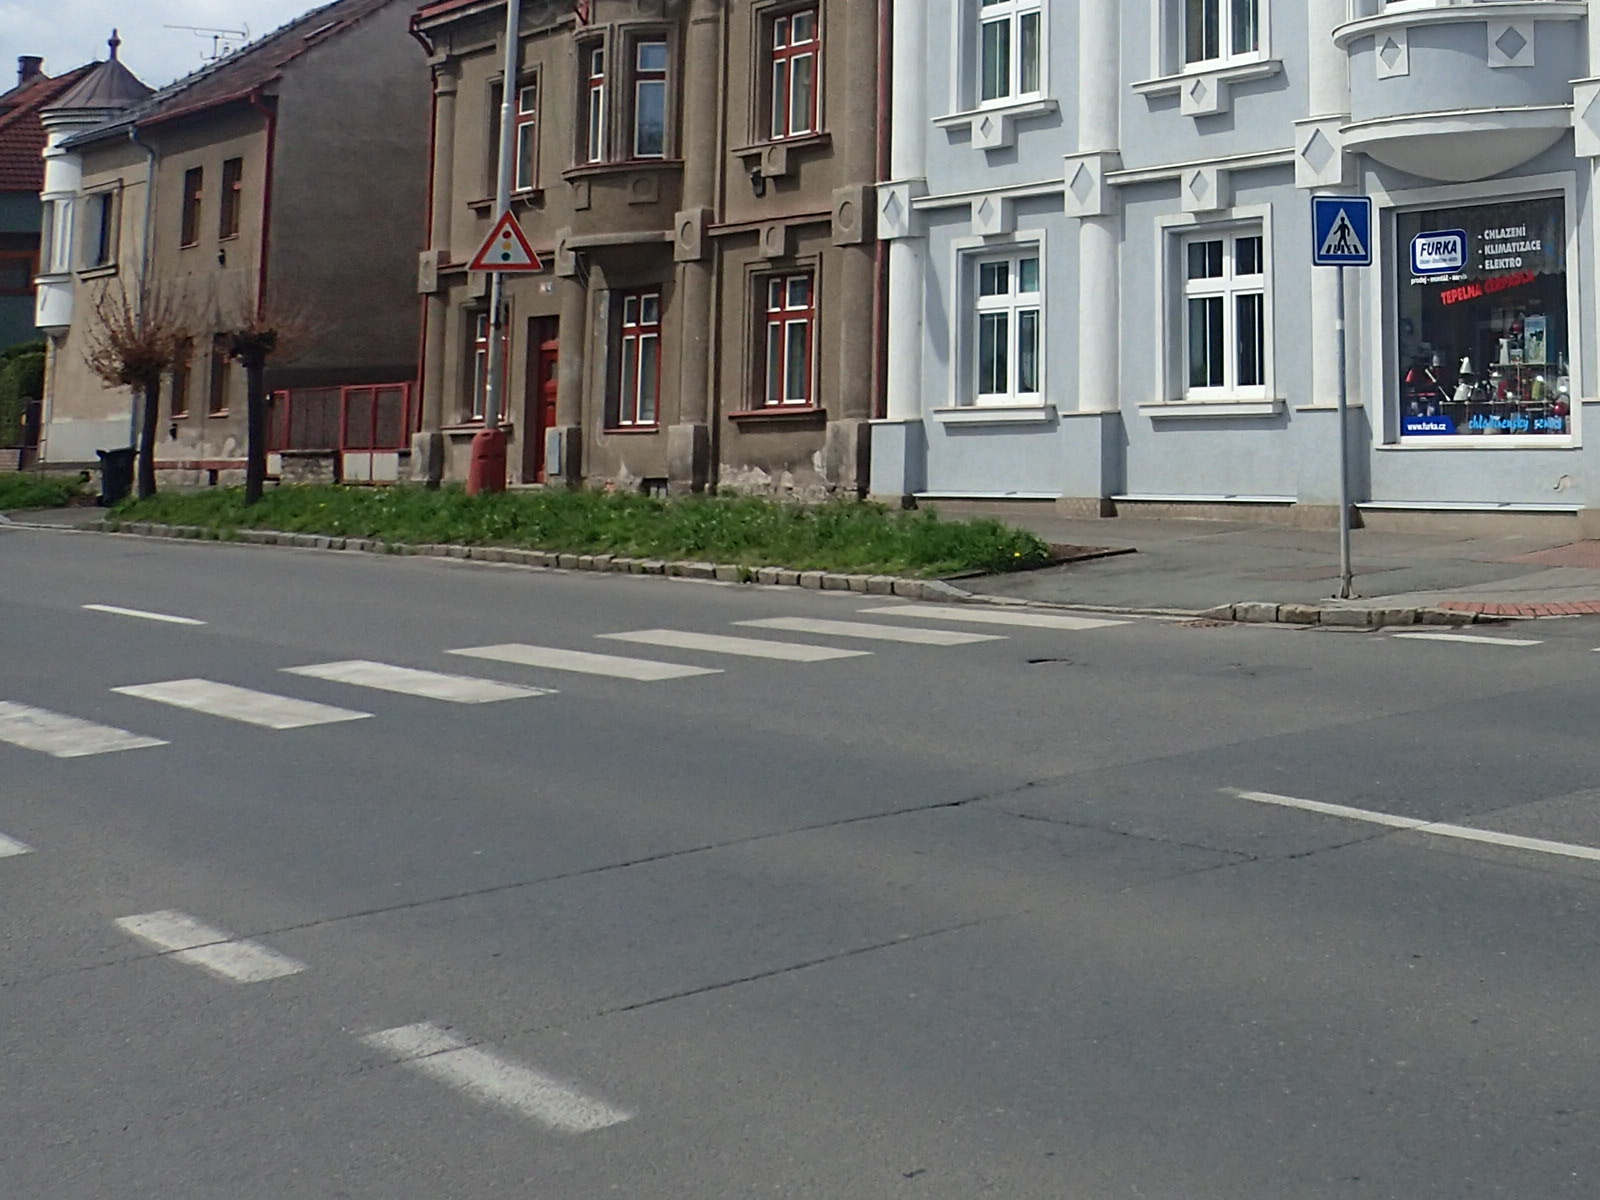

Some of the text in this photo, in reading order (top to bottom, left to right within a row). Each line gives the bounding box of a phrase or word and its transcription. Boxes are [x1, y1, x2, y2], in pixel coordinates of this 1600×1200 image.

[1484, 224, 1526, 240] CHLAZENÍ
[1420, 240, 1457, 256] FURKA
[1484, 240, 1541, 255] KLIMATIZACE
[1485, 257, 1522, 270] ELEKTRO
[1441, 279, 1483, 305] TEPELNÁ
